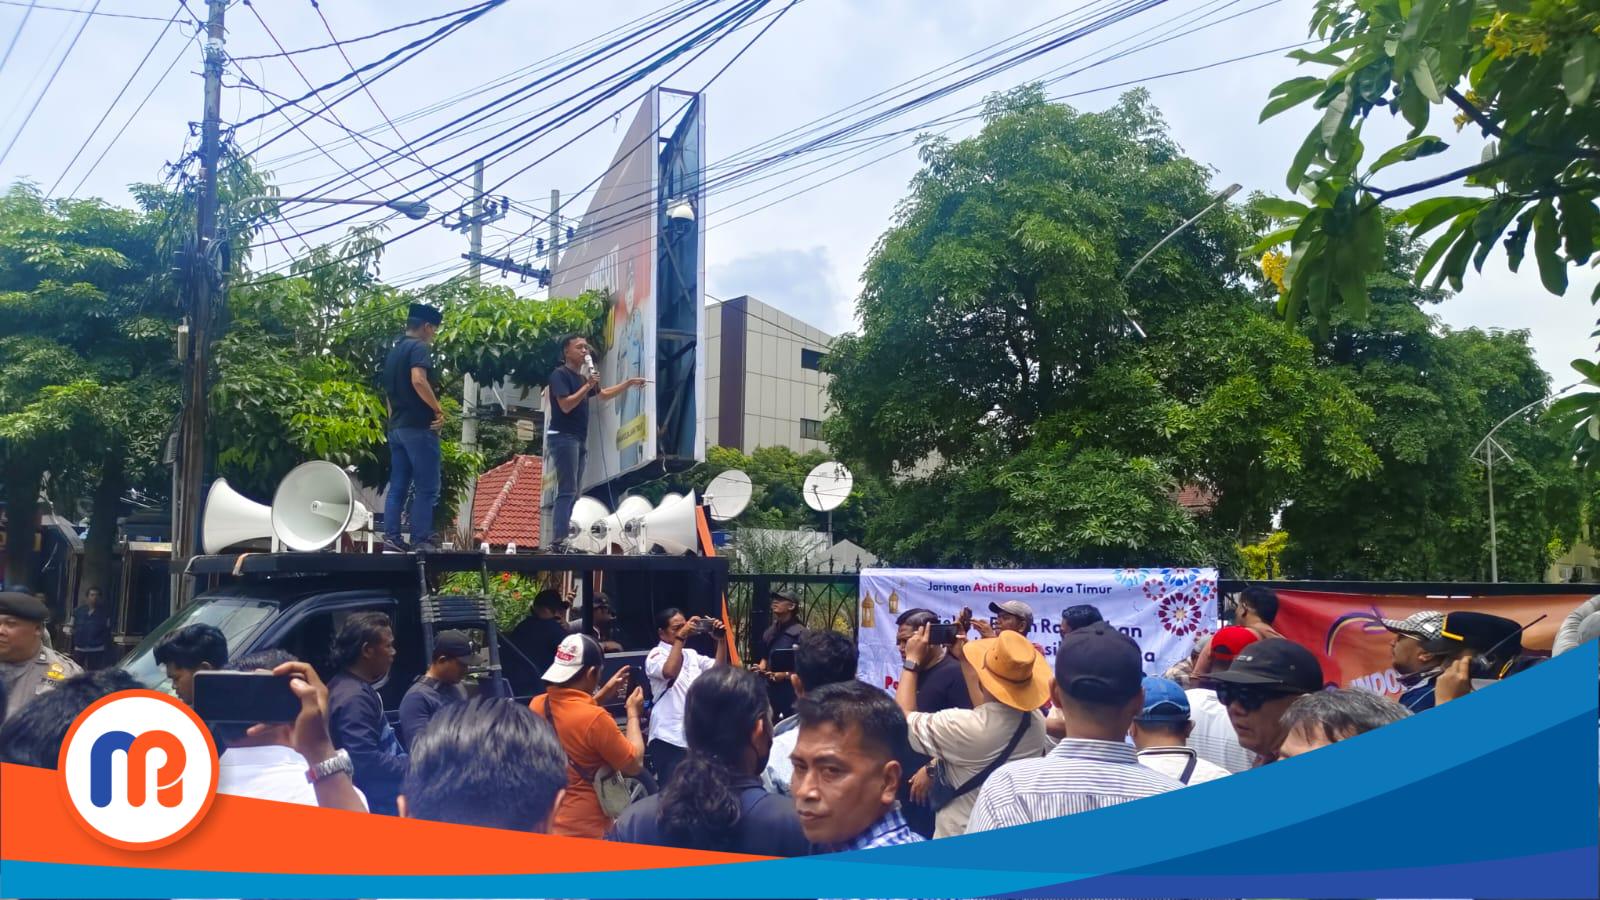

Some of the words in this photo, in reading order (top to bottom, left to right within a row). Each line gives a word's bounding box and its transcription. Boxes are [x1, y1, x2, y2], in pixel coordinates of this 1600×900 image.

[927, 581, 972, 594] Jaringan
[973, 582, 996, 593] Anti
[997, 582, 1038, 593] Rasuah
[1040, 583, 1073, 594] Jawa
[1075, 583, 1112, 594] Timur
